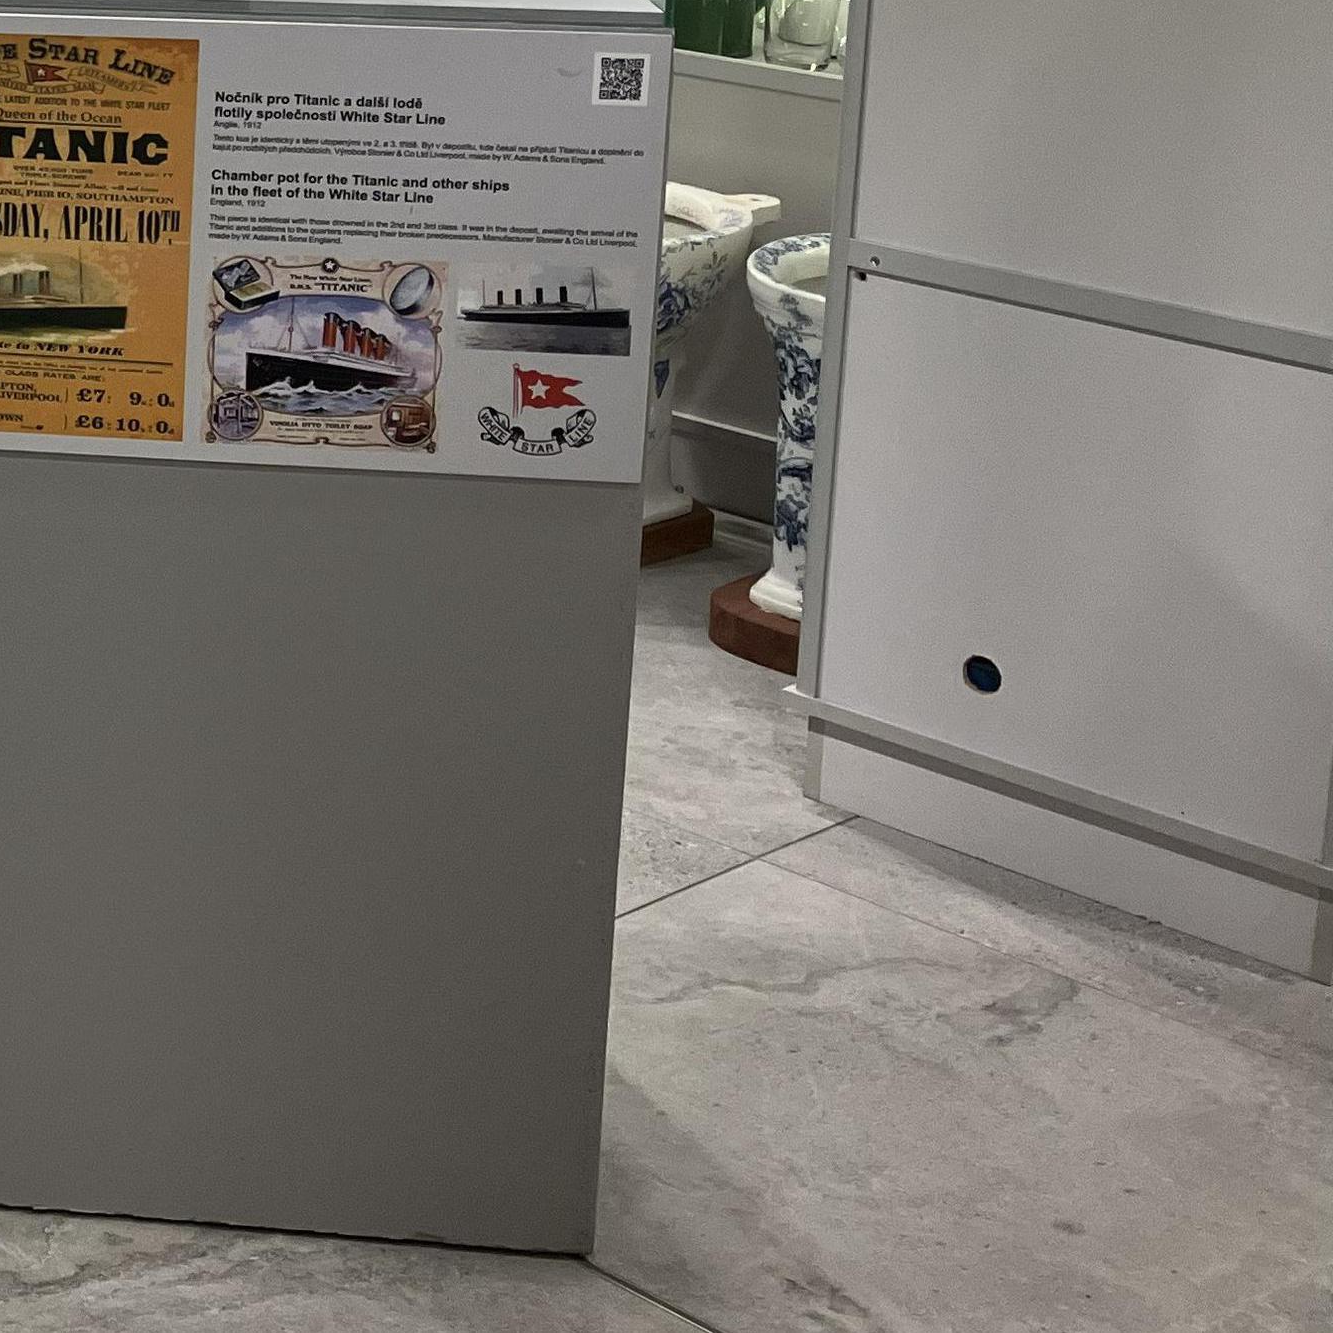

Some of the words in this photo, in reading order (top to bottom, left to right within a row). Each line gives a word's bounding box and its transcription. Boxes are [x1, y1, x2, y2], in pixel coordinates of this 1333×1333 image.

[28, 38, 99, 66] STAR
[109, 49, 176, 86] LINE
[4, 94, 31, 104] LATEST
[34, 96, 68, 106] ADDITION
[70, 97, 80, 106] TO
[83, 98, 97, 108] THE
[100, 99, 123, 109] WHITE
[125, 100, 145, 110] STAR
[148, 102, 170, 111] FLEET
[215, 92, 262, 104] Nočník
[267, 96, 290, 106] pro
[294, 94, 339, 107] Titanic
[344, 98, 352, 106] a
[356, 96, 389, 108] další
[393, 97, 422, 109] lodě
[39, 109, 54, 121] of
[56, 111, 77, 122] the
[80, 112, 122, 124] Ocean
[214, 107, 252, 120] flotily
[256, 109, 336, 122] společnosti
[340, 111, 380, 123] White
[383, 113, 411, 124] Star
[416, 114, 446, 125] Line
[211, 170, 274, 183] Chamber
[277, 174, 300, 185] pot
[304, 173, 323, 184] for
[327, 174, 348, 185] the
[353, 175, 398, 187] Titanic
[402, 177, 428, 188] and
[432, 178, 469, 190] other
[472, 179, 510, 193] ships
[26, 189, 54, 198] PIER
[76, 192, 174, 204] SOUTHAMPTON
[211, 184, 223, 195] in
[227, 185, 249, 196] the
[253, 186, 282, 197] fleet
[286, 187, 300, 198] of
[303, 188, 325, 199] the
[328, 189, 368, 201] White
[372, 191, 400, 202] Star
[404, 192, 434, 203] Line
[210, 198, 244, 207] England,
[247, 199, 265, 207] 1912
[58, 204, 128, 242] APRIL
[15, 340, 31, 350] to
[33, 342, 70, 353] NEW
[78, 345, 125, 356] YORK
[481, 412, 507, 441] WHITE
[521, 443, 553, 453] STAR
[569, 418, 592, 443] LINE
